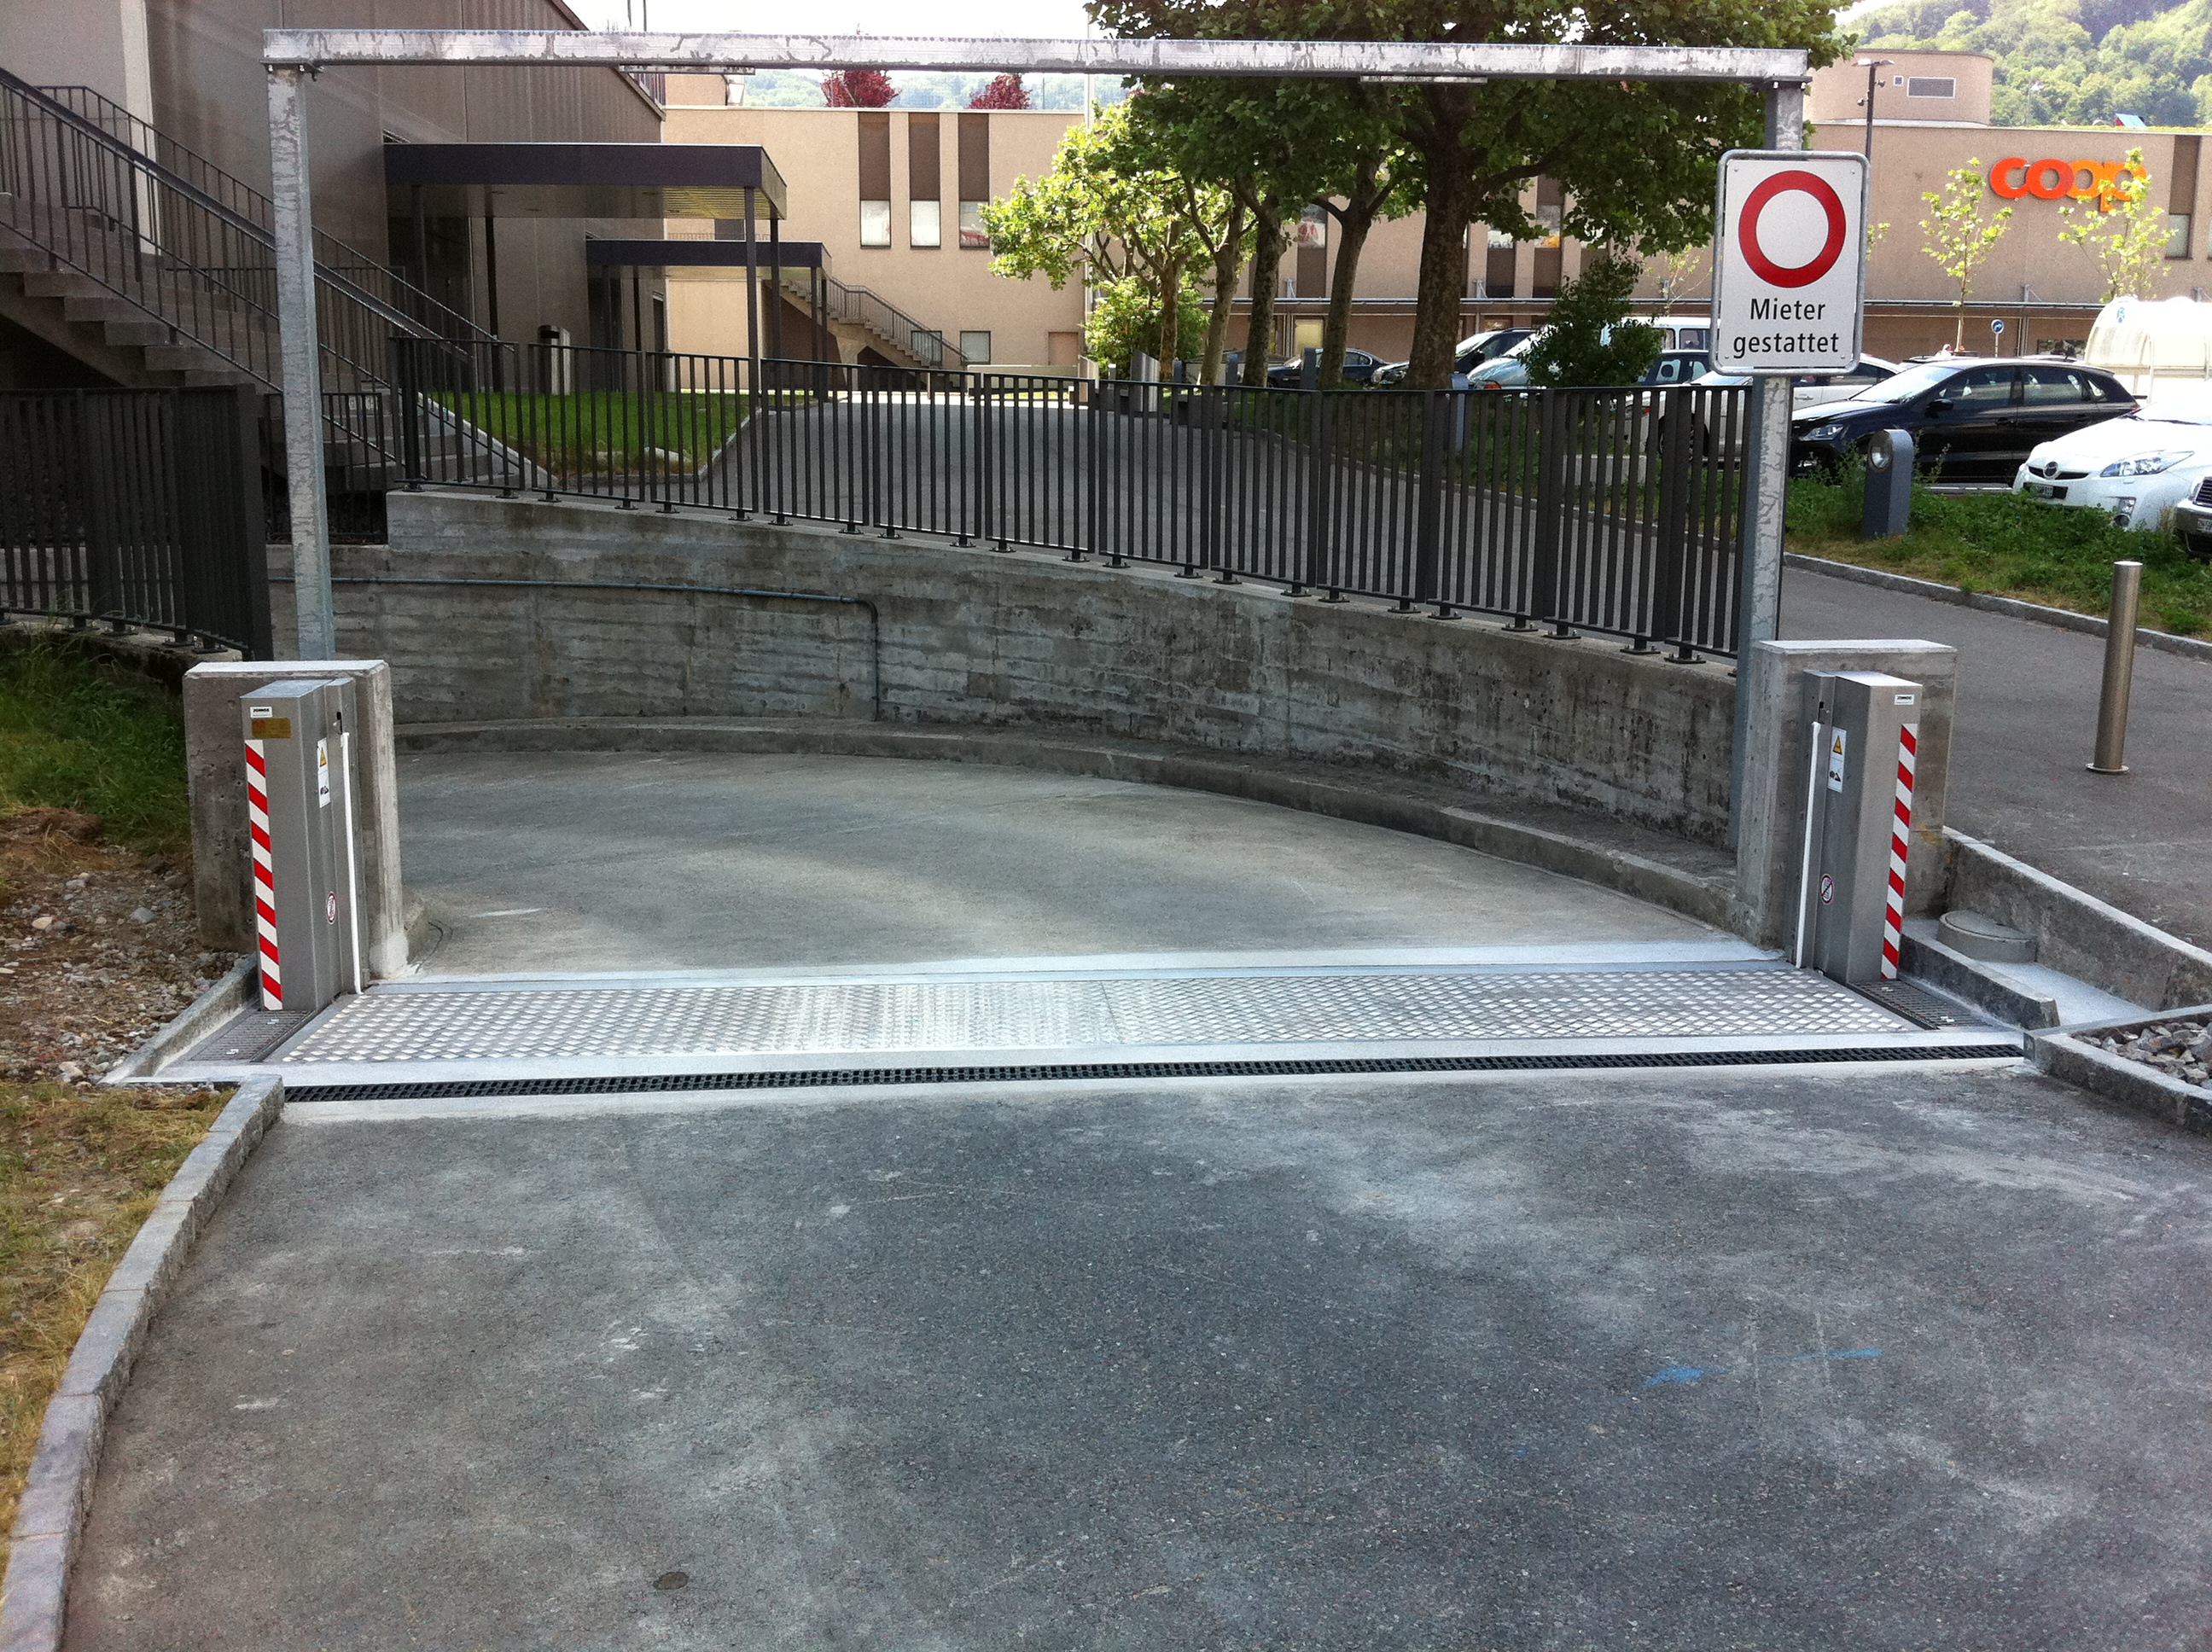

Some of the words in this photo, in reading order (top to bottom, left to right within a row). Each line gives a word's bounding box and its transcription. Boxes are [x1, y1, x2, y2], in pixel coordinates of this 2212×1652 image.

[1991, 157, 2148, 212] coop
[1750, 298, 1825, 320] Mieter
[1733, 333, 1839, 358] gestattet
